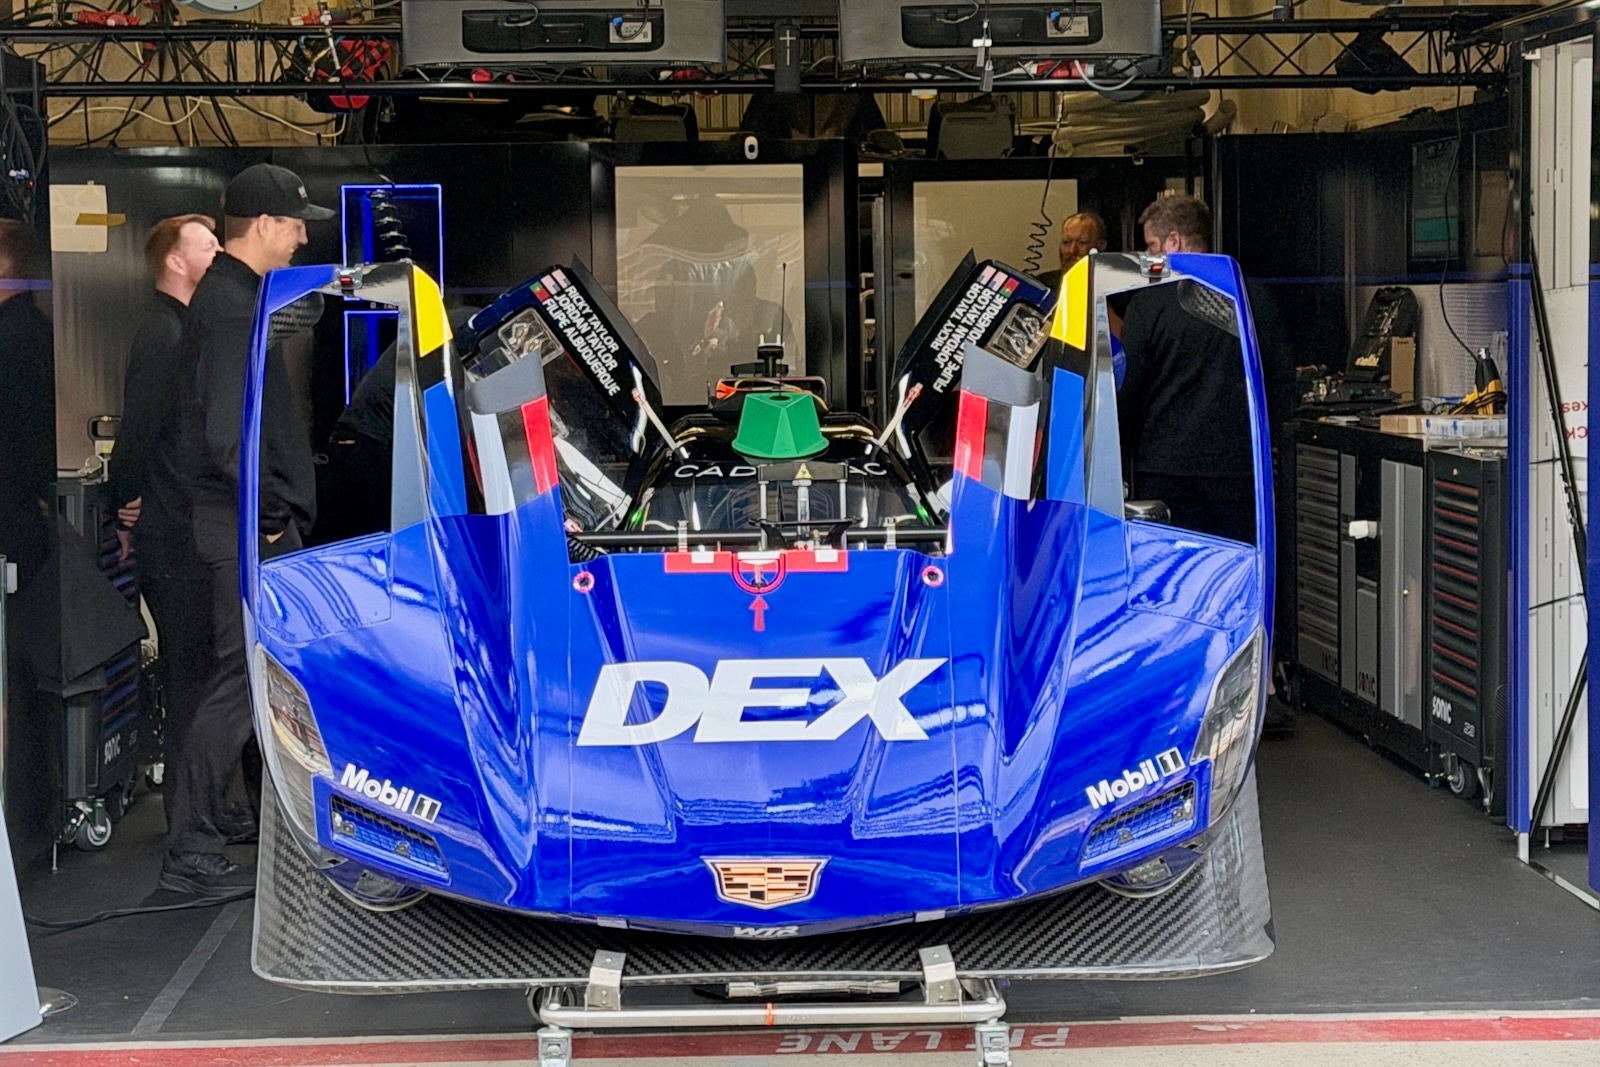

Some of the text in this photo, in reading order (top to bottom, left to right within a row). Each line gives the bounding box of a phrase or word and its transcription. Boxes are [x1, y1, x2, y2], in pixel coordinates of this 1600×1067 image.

[541, 298, 621, 396] FILIPE ALBUQUERQUE
[553, 294, 618, 371] JORDAN TAYLOR
[565, 285, 620, 354] RICKY TAYLOR
[930, 282, 984, 351] RICKY TAYLOR
[932, 294, 1008, 394] FILIPE AUQUERQUE
[934, 288, 996, 369] JORDAN TAYLOR
[674, 462, 888, 478] CADAC
[576, 657, 949, 746] DEX
[340, 762, 415, 813] Mobil
[1085, 758, 1160, 810] Mobil
[733, 925, 800, 938] WTR
[777, 1027, 1070, 1052] PI LANE
